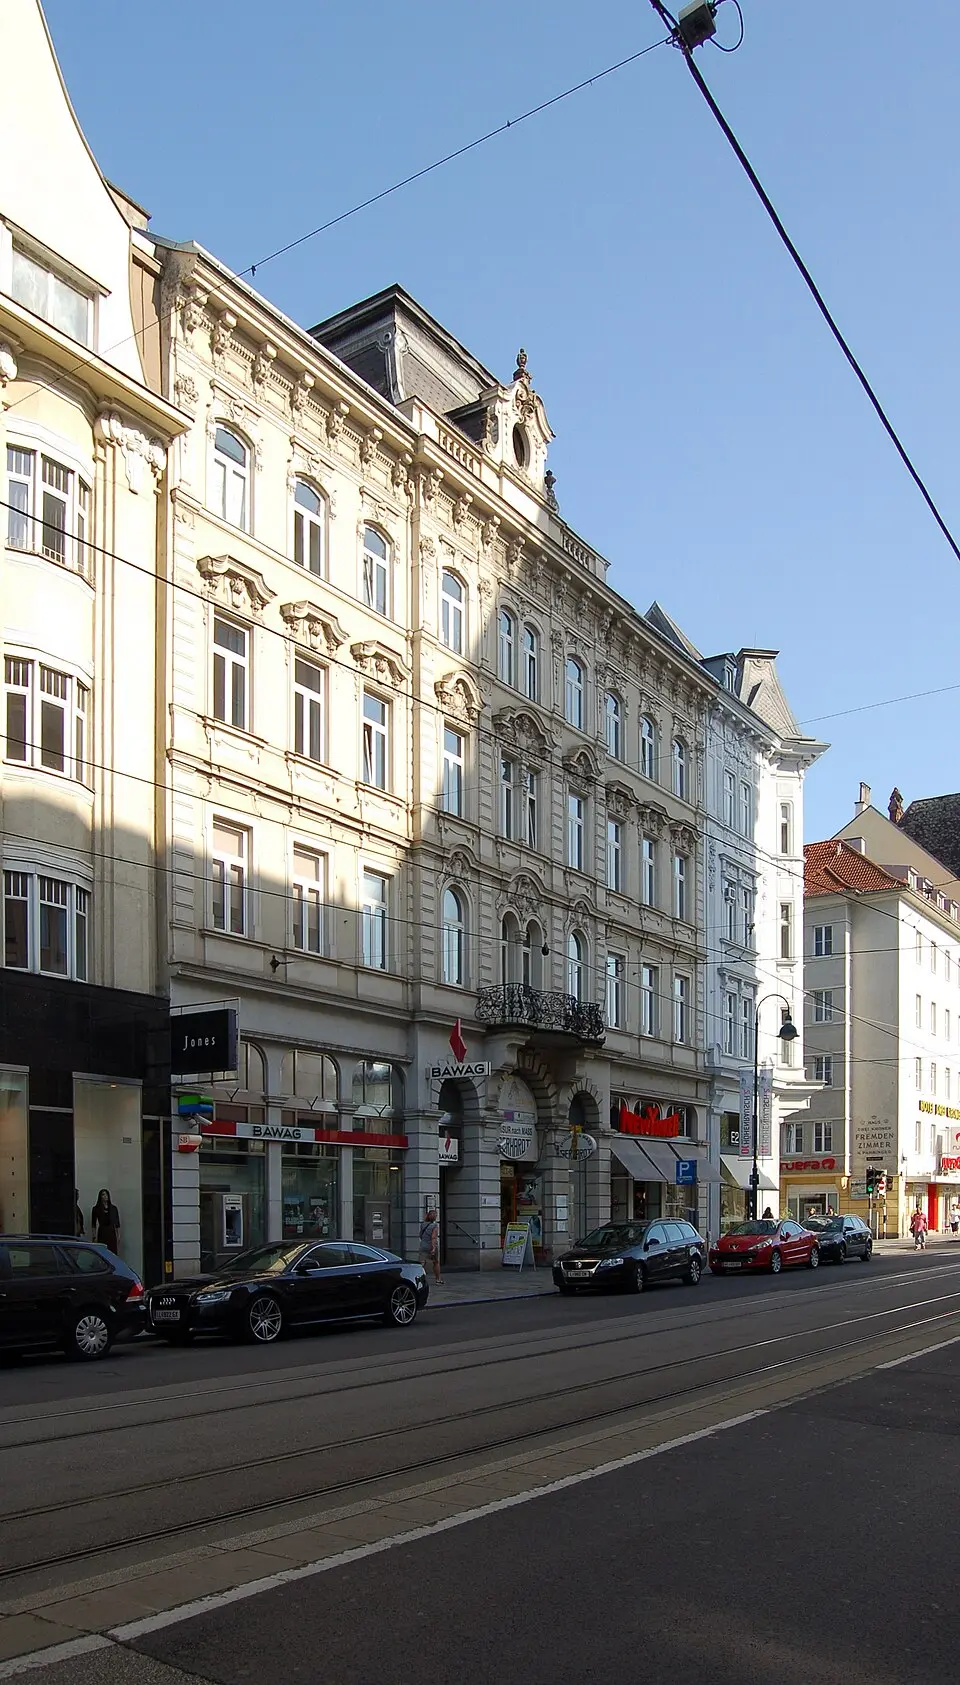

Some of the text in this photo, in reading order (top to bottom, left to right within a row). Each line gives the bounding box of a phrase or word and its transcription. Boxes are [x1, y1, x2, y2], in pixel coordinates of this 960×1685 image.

[182, 1035, 216, 1051] Jones
[431, 1063, 485, 1078] BAWAG
[252, 1125, 302, 1140] BAWAG
[855, 1132, 895, 1141] FREMDEN
[858, 1141, 892, 1149] ZIMMER
[679, 1161, 690, 1177] P
